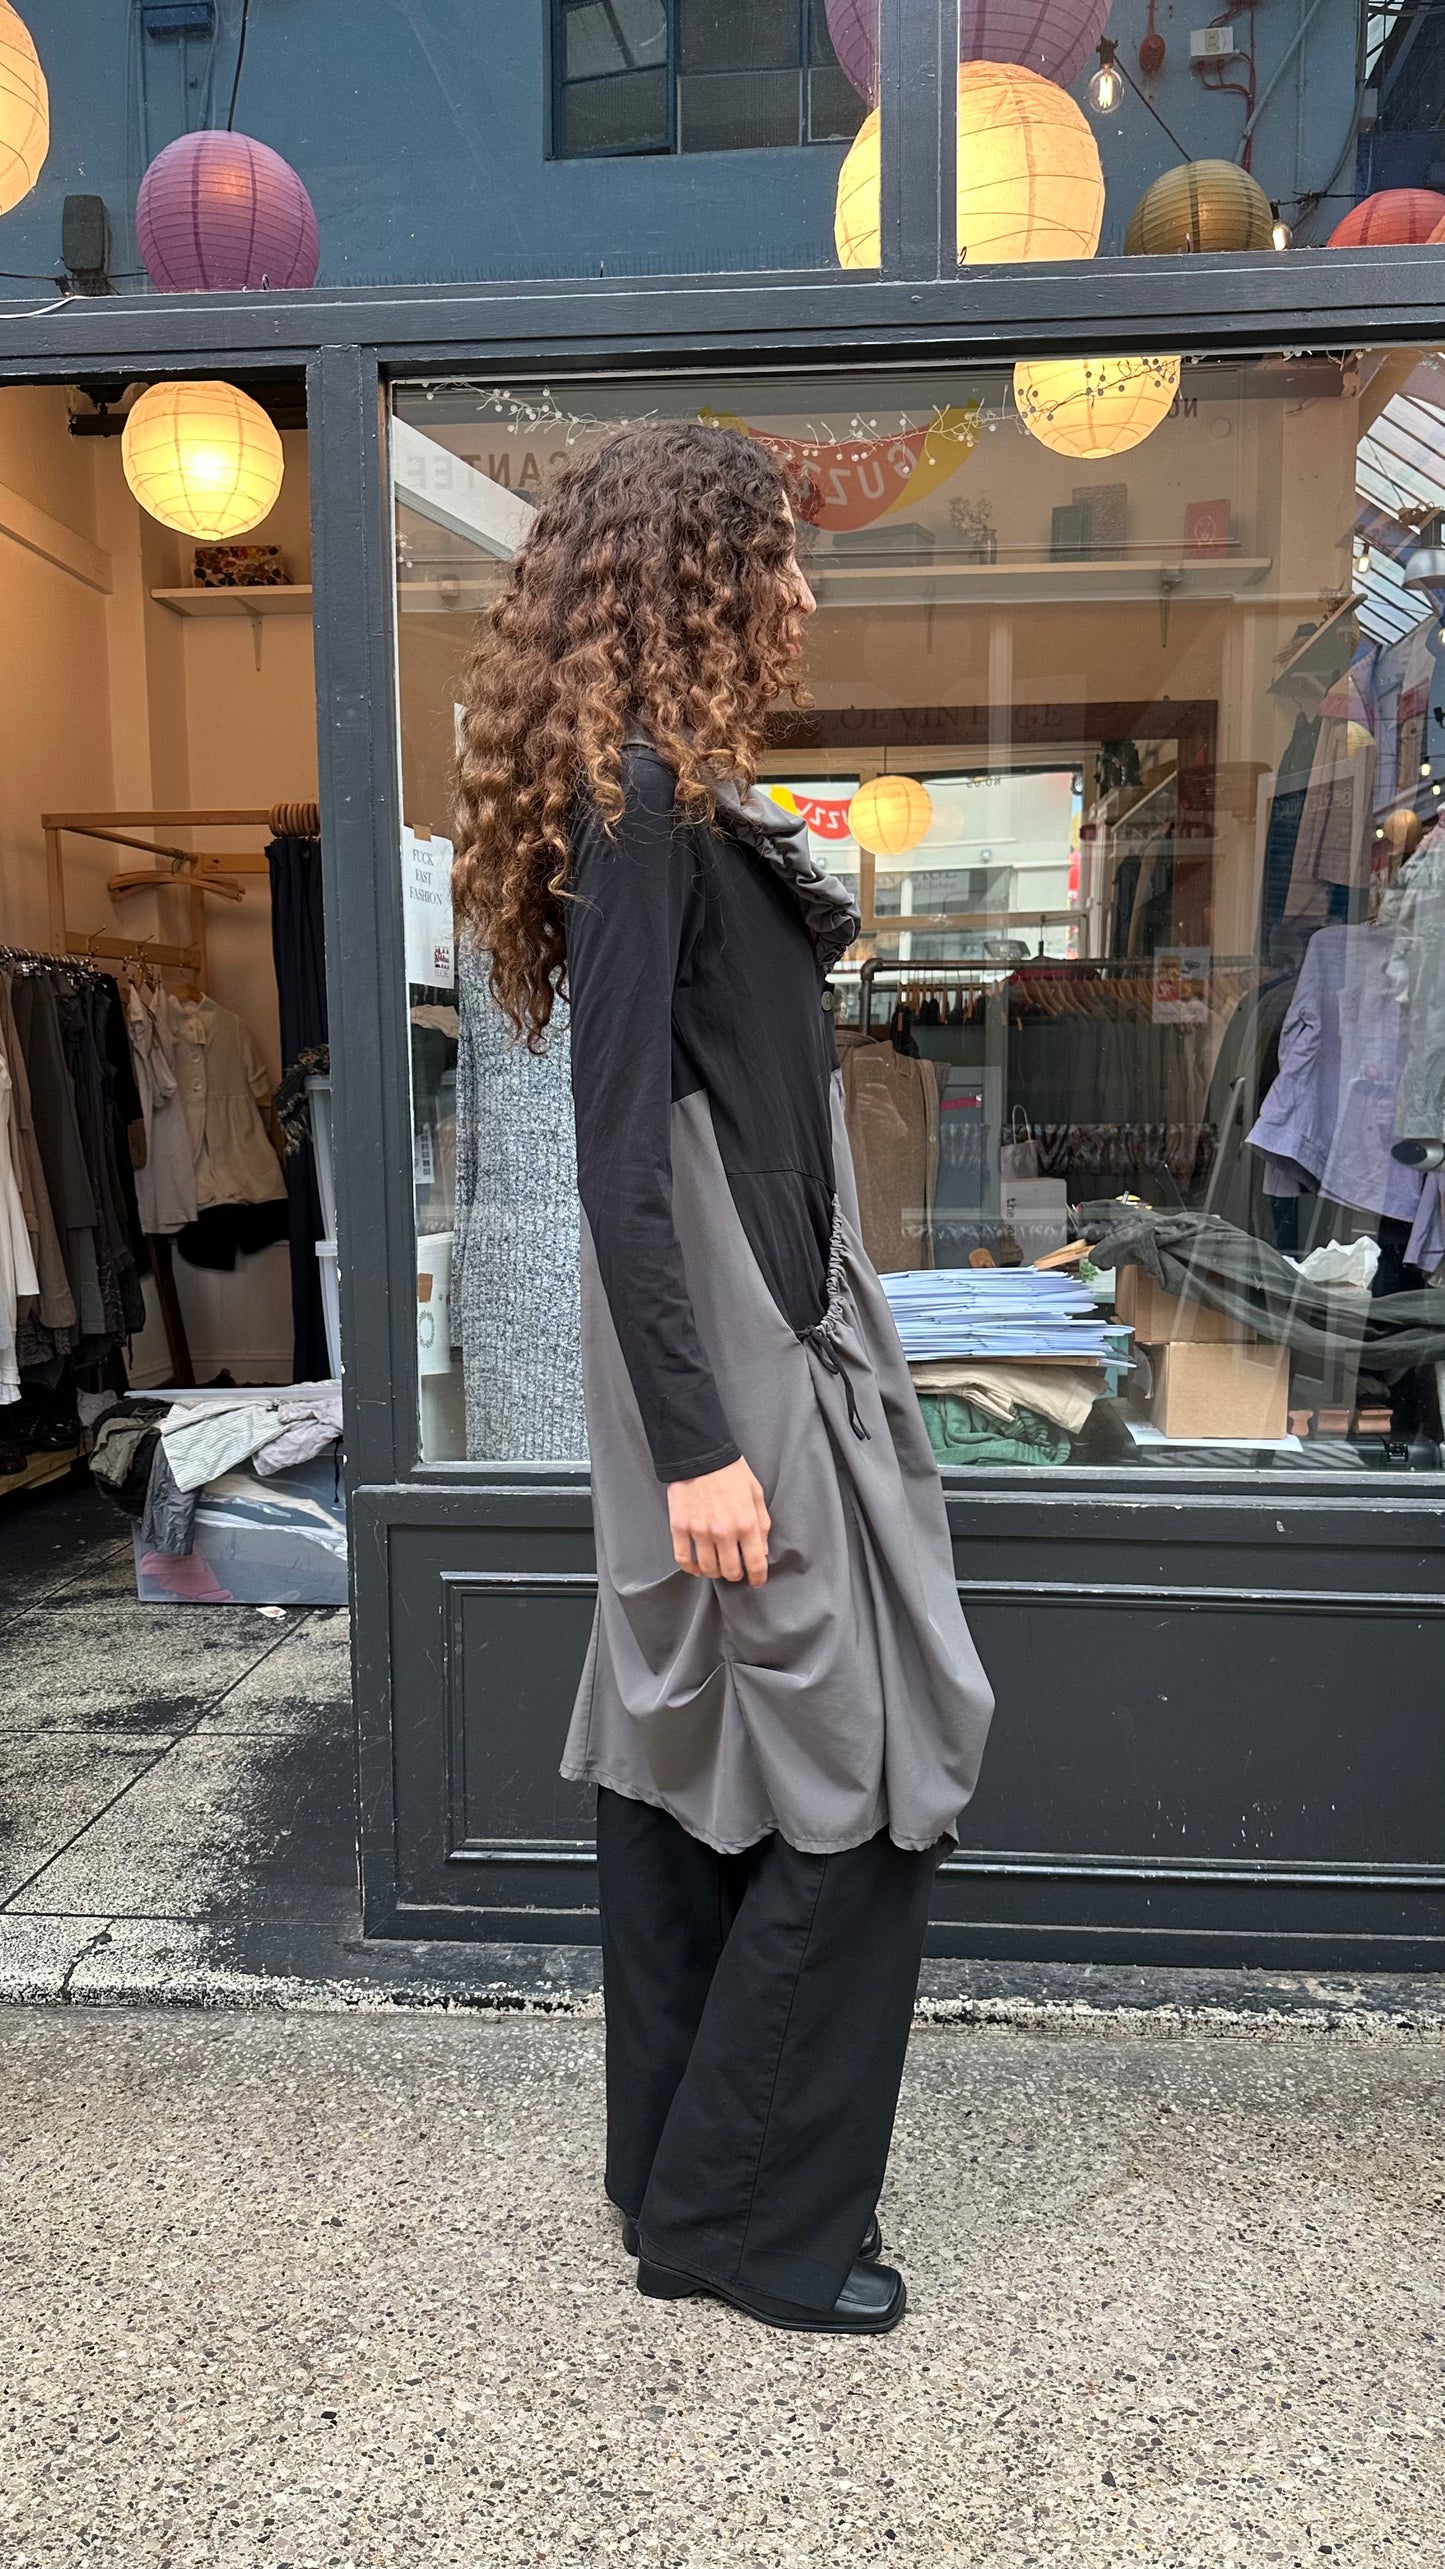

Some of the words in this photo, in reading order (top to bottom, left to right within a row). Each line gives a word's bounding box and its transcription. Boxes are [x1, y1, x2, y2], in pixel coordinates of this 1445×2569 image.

[899, 704, 1063, 730] VINTGE
[412, 848, 434, 866] FUCK
[415, 868, 432, 885] FAST
[409, 886, 442, 905] FASHION
[1006, 1198, 1017, 1219] the
